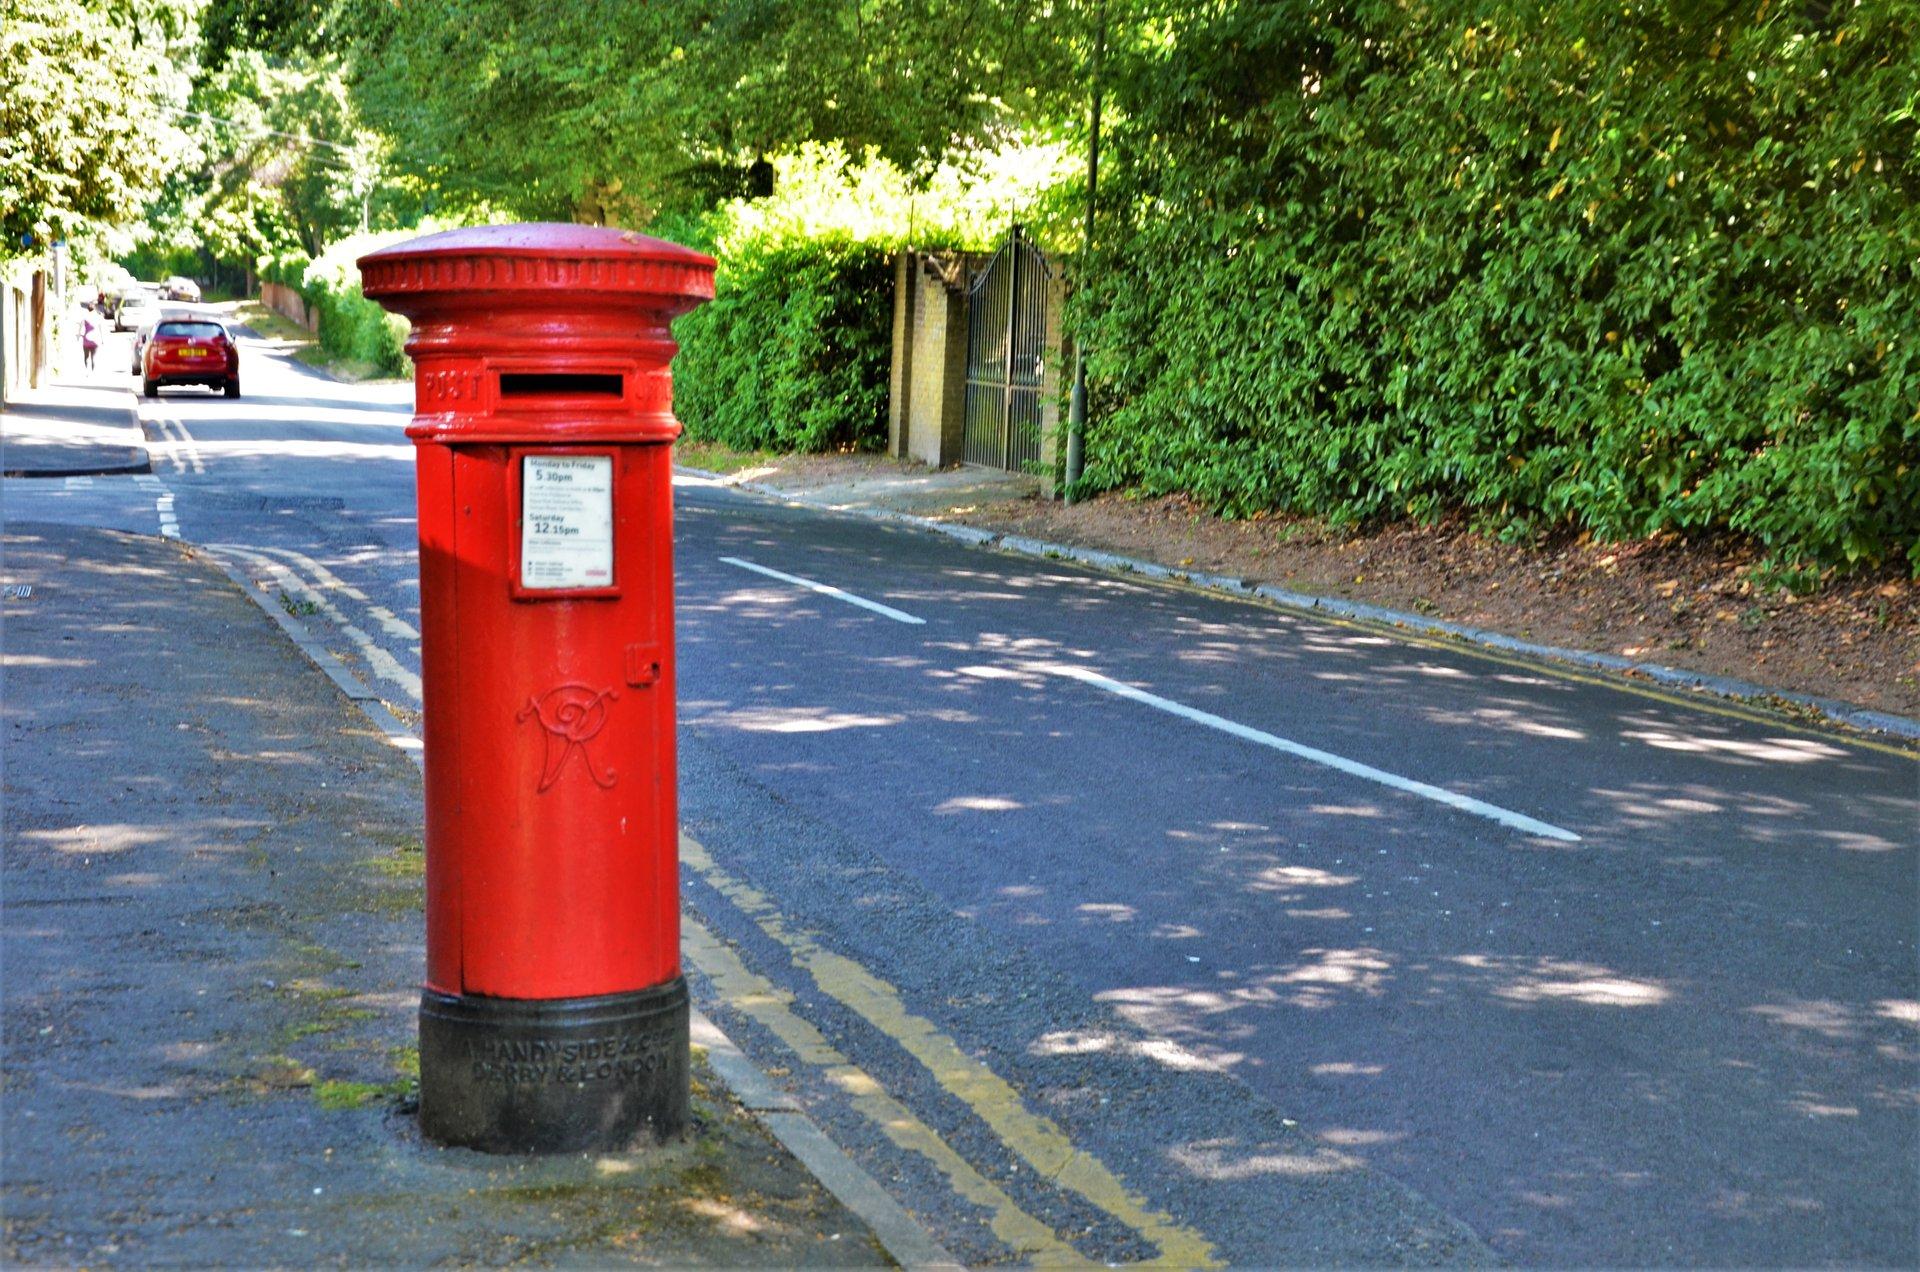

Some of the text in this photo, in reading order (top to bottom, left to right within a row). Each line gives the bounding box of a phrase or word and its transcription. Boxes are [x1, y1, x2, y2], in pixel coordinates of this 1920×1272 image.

[530, 459, 560, 469] Monday
[571, 461, 596, 470] Friday
[529, 513, 565, 522] Saturday
